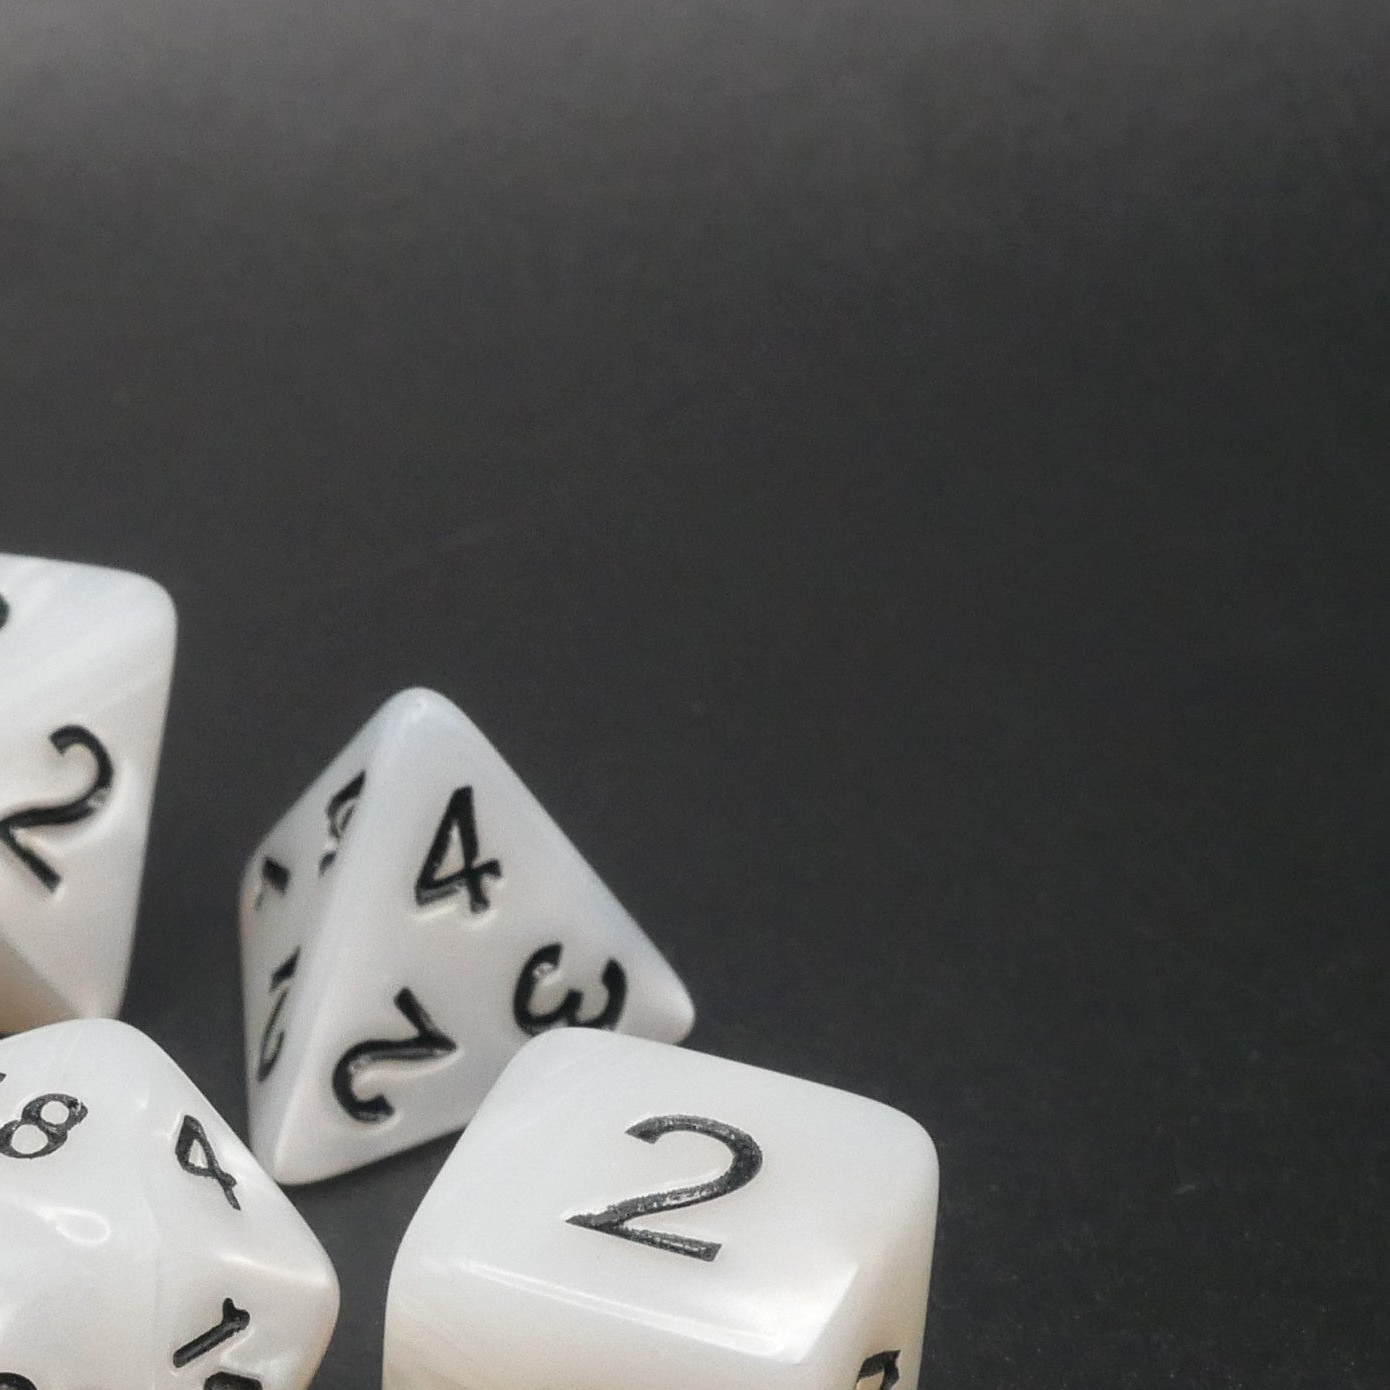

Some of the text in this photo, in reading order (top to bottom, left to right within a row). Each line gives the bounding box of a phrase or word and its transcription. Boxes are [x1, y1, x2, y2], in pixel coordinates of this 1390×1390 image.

[414, 785, 503, 915] 4
[331, 986, 457, 1124] 2
[513, 942, 628, 1038] 3
[174, 1113, 242, 1212] 4
[563, 1113, 764, 1262] 2
